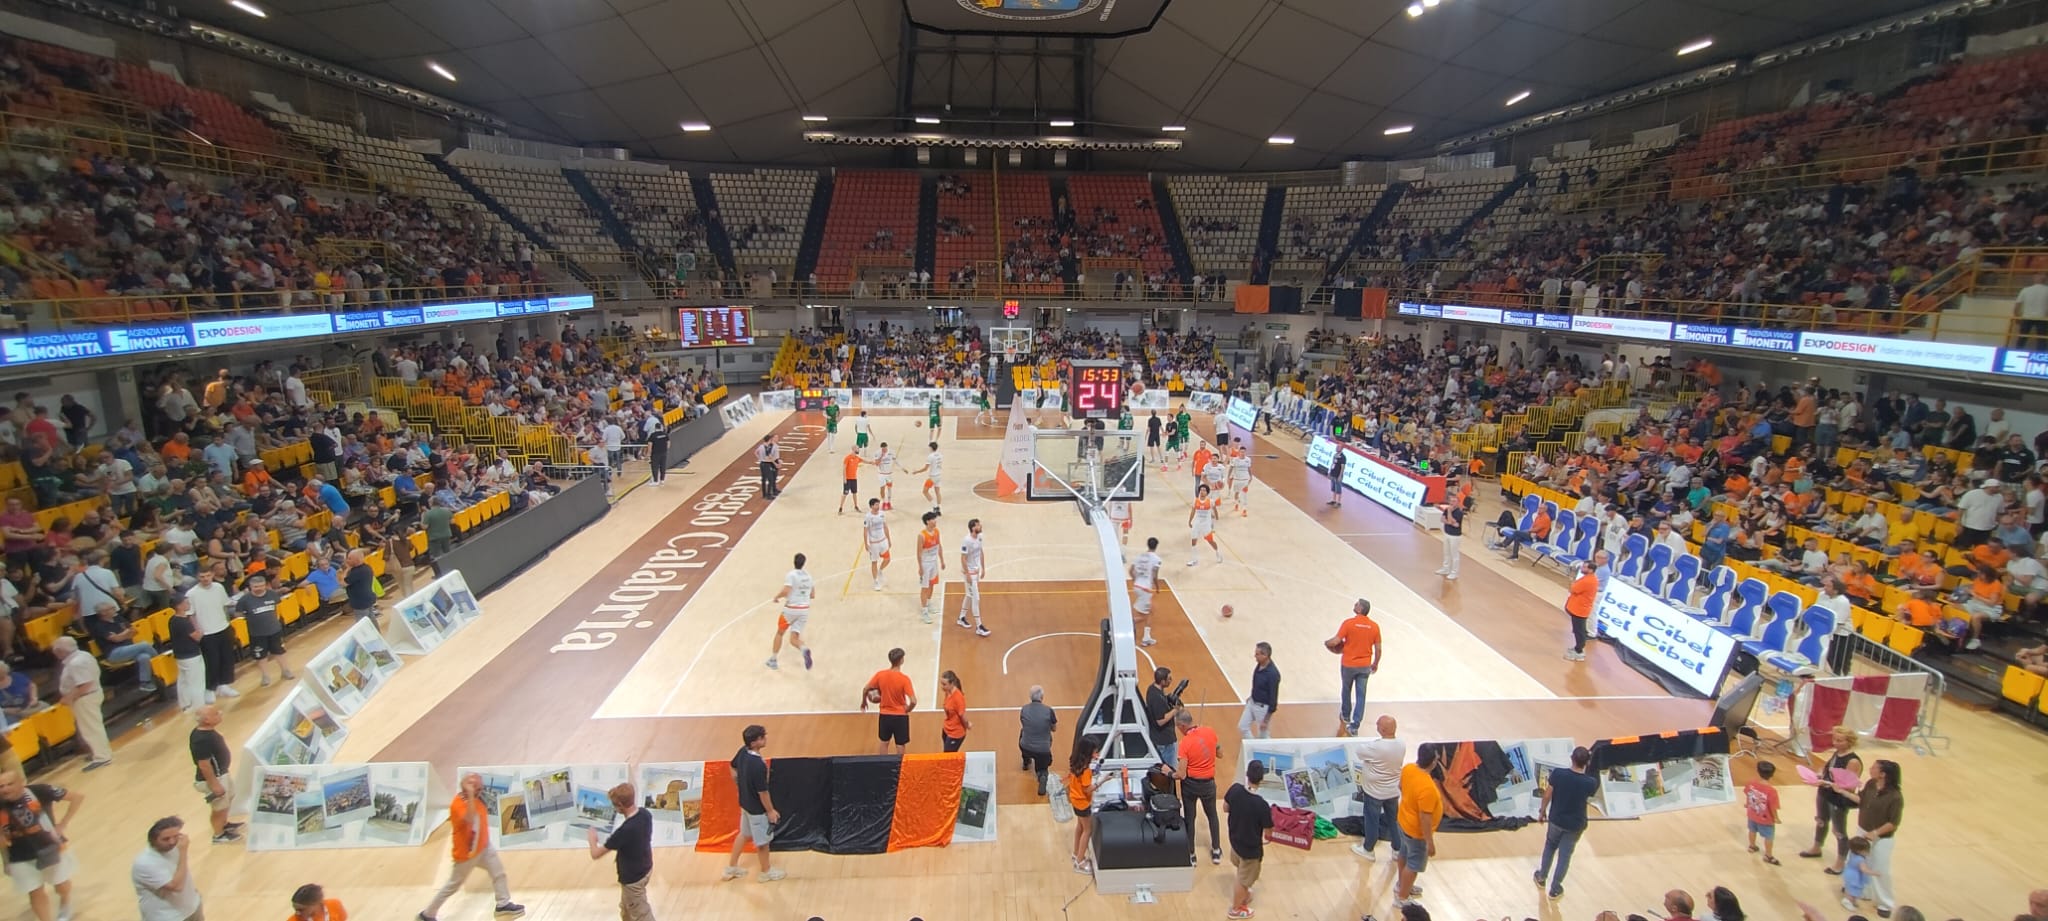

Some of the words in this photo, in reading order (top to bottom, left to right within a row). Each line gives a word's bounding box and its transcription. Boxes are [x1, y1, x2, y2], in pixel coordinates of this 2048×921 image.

[128, 327, 161, 337] AGENZIA
[161, 326, 185, 334] VIAGGI
[198, 325, 262, 339] EXPODESIGN
[1574, 319, 1613, 330] EXPODESIGN
[1674, 324, 1727, 344] SIMONETTA
[1747, 329, 1772, 338] AGENZIA
[1773, 332, 1794, 340] VIAGGI
[27, 335, 68, 345] AGENZIA
[68, 332, 98, 342] VIAGGI
[109, 330, 189, 351] SIMONETTA
[1732, 328, 1793, 350] SIMONETTA
[1803, 338, 1876, 354] EXPODESIGN
[3, 338, 103, 362] SIMONETTA
[1082, 368, 1119, 382] 15:53
[1079, 383, 1116, 409] 24
[1313, 444, 1332, 457] Cibel
[1360, 467, 1386, 484] Cibel
[1387, 481, 1417, 500] Cibel
[1357, 477, 1382, 494] Cibel
[1383, 491, 1413, 510] Cibel
[549, 531, 731, 653] Calabria
[1643, 613, 1713, 658] Cibel
[1636, 630, 1705, 676] Cibel
